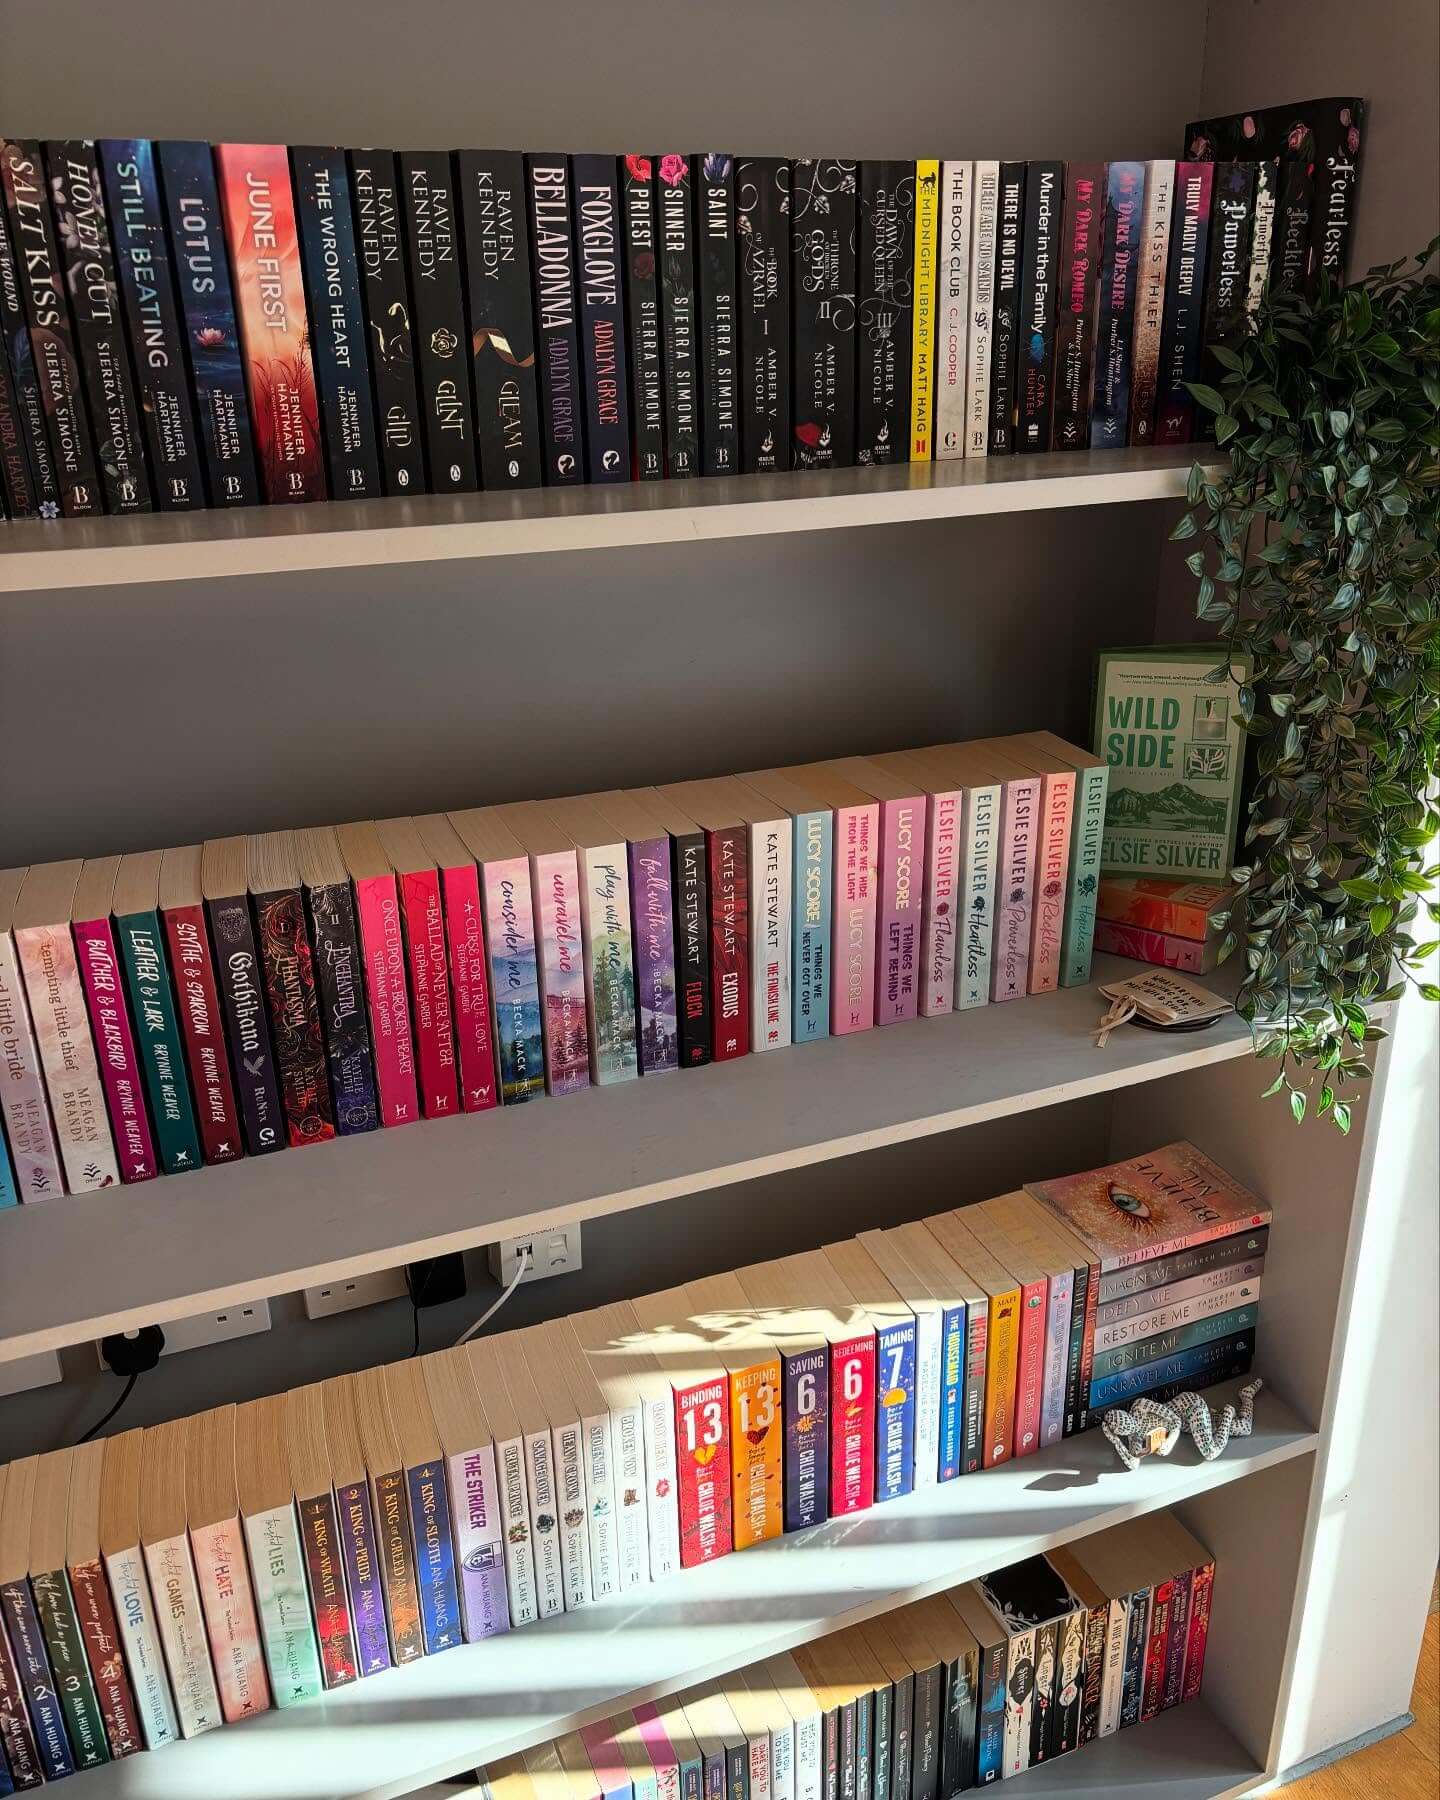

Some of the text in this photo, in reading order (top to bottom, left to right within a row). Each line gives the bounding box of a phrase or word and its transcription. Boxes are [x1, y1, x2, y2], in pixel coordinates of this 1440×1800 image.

[9, 157, 60, 325] SALT KISS
[67, 160, 112, 323] HONEY CUT
[356, 169, 382, 281] KENNEDY
[377, 188, 399, 261] RAVEN
[411, 170, 436, 280] KENNEDY
[431, 189, 452, 261] RAVEN
[580, 186, 617, 305] FOXGLOVE
[629, 188, 652, 248] PRIEST
[664, 190, 686, 251] SINNER
[707, 188, 728, 239] SAINT
[949, 169, 964, 298] THE BOOK CLUB
[1000, 183, 1019, 291] THERE IS NO DEVIL
[1178, 176, 1202, 296] TRULY MADLY DEEPLY
[1322, 157, 1355, 267] Fearless
[117, 163, 168, 368] STILL BEATING
[180, 199, 215, 293] LOTUS
[246, 172, 288, 333] JUNE FIRST
[314, 169, 351, 368] THE WRONG HEART
[532, 167, 573, 329] BELLADONNA
[918, 198, 931, 347] MIDNIGHT LIBRARY
[1031, 173, 1054, 333] Murder in the Family
[1070, 179, 1093, 313] MY DARK ROMEO
[1147, 183, 1168, 328] THE KISS THIEF
[1217, 199, 1246, 308] Powerless
[593, 320, 619, 425] ADALYN GRACE
[641, 302, 660, 430] SIERRA SIMONE
[916, 354, 927, 432] MATT HAIG
[44, 342, 78, 472] SIERRA SIMONE
[156, 391, 187, 461] JENNIFER HARTMANN
[386, 406, 412, 447] GILD
[436, 380, 464, 440] GLINT
[498, 381, 523, 449] GLEAM
[1107, 695, 1181, 731] WILD
[1106, 732, 1177, 770] SIDE
[806, 818, 822, 922] LUCY SCORE
[895, 808, 913, 911] LUCY SCORE
[936, 799, 955, 898] ELSIE SILVER
[1155, 844, 1221, 871] SILVER
[381, 899, 397, 936] ONCE
[553, 874, 577, 974] unravel me
[593, 864, 622, 969] play with me
[722, 840, 736, 956] KATE STEWART
[767, 833, 778, 948] KATE STEWART
[86, 939, 117, 992] BUTCHER
[130, 929, 160, 981] LEATHER
[176, 922, 203, 963] SCYTHE
[385, 938, 400, 975] UPON
[500, 880, 525, 989] consider me
[888, 922, 900, 1002] LEFT BEHIND
[901, 923, 913, 995] THINGS WE
[933, 917, 952, 983] Flawless
[967, 911, 989, 978] Heartless
[1006, 906, 1026, 979] Powerless
[228, 951, 260, 1052] Gothikana
[722, 972, 739, 1018] EXODUS
[767, 961, 780, 1025] THE FINISH LINE
[801, 931, 811, 1016] NEVER GOT OVER
[813, 944, 823, 999] THINGS WE
[40, 942, 80, 1071] tempting little thief
[100, 1009, 127, 1070] BLACKBIRD
[142, 999, 165, 1032] LARK
[186, 981, 211, 1036] SPARROW
[391, 991, 408, 1039] BROKEN
[512, 999, 527, 1072] BECKA MACK
[397, 1039, 412, 1075] HEART
[116, 1079, 144, 1156] BRYNNE WEAVER
[1103, 1266, 1173, 1297] IMAGINE ME
[833, 1339, 874, 1360] REDEEMING
[880, 1328, 914, 1350] TAMING
[1102, 1304, 1191, 1346] RESTORE ME
[681, 1385, 723, 1409] BINDING
[735, 1367, 776, 1392] KEEPING
[789, 1354, 824, 1377] SAVING
[797, 1373, 816, 1415] 6
[843, 1358, 863, 1401] 6
[887, 1346, 905, 1389] 7
[683, 1402, 723, 1452] 13
[738, 1383, 775, 1434] 13
[421, 1482, 437, 1514] KING
[463, 1453, 487, 1530] THE STRIKER
[697, 1480, 717, 1550] CHLOE WALSH
[267, 1546, 286, 1578] LIES
[313, 1518, 328, 1548] KING
[425, 1525, 442, 1566] SLOTH
[123, 1590, 144, 1628] LOVE
[214, 1565, 234, 1600] HATE
[320, 1558, 336, 1599] WRATH
[33, 1684, 57, 1702] 2
[65, 1675, 81, 1693] 3
[102, 1664, 118, 1679] 4
[40, 1706, 62, 1760] ANA HUANG
